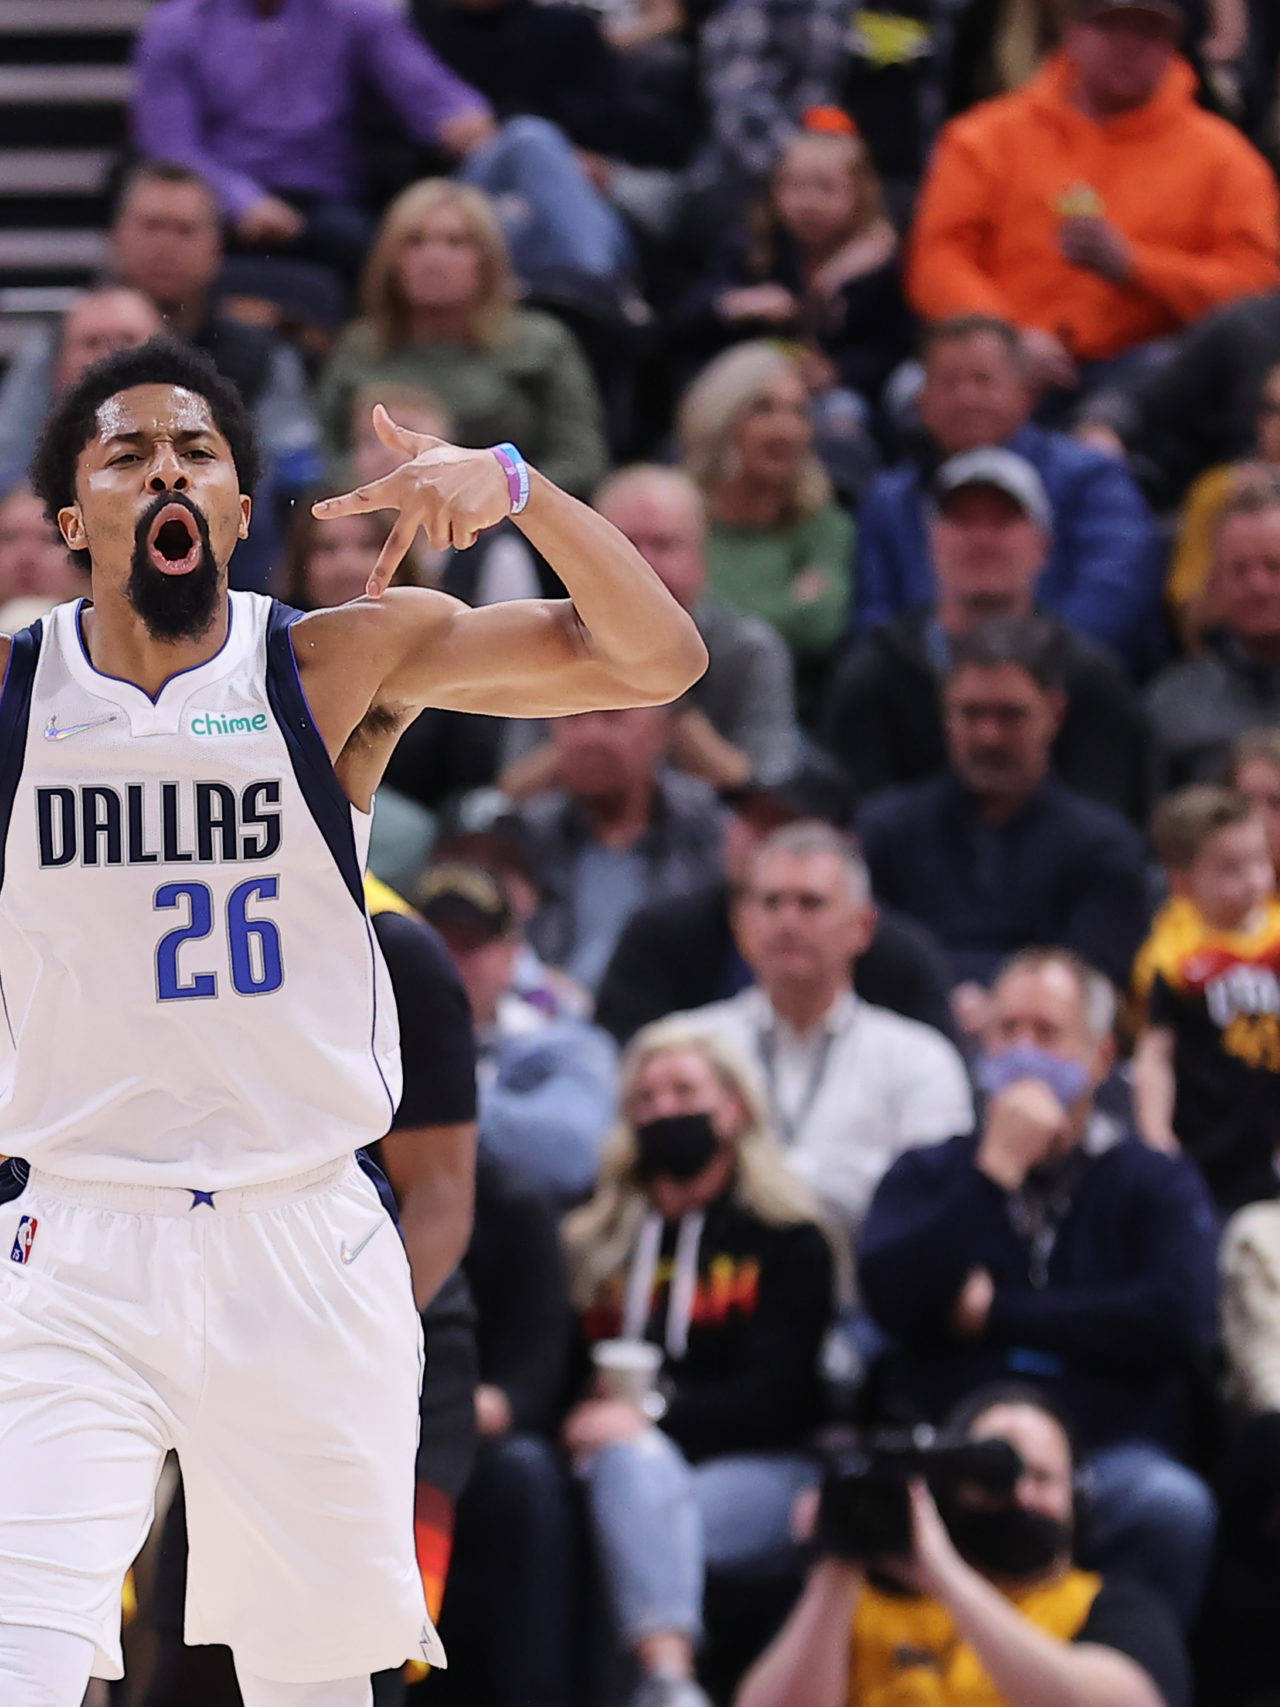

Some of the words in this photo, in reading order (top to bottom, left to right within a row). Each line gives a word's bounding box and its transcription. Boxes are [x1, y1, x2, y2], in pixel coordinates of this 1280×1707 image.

[191, 713, 268, 735] chime
[34, 779, 283, 869] DALLAS
[152, 873, 285, 1003] 26
